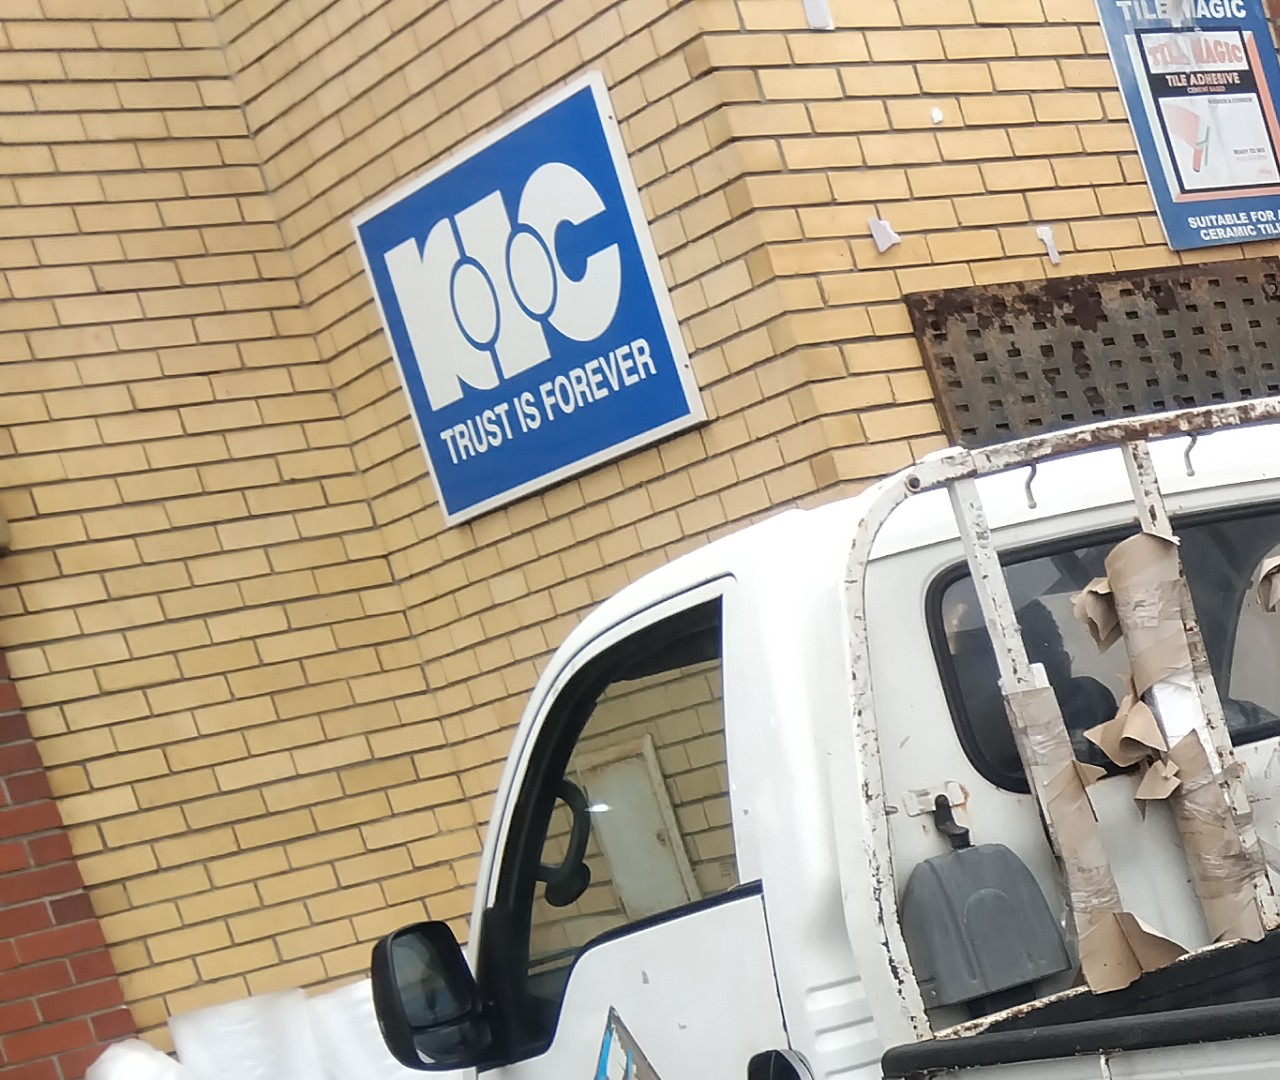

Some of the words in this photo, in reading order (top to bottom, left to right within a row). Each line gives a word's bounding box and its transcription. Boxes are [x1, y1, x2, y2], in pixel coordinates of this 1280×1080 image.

[1165, 74, 1188, 87] TILE
[1189, 72, 1241, 86] ADHESIVE
[1188, 212, 1250, 229] SUITABLE
[1249, 210, 1276, 222] FOR
[1200, 224, 1257, 241] CERAMIC
[440, 403, 513, 464] TRUST
[514, 392, 541, 433] IS
[539, 338, 657, 421] FOREVER
